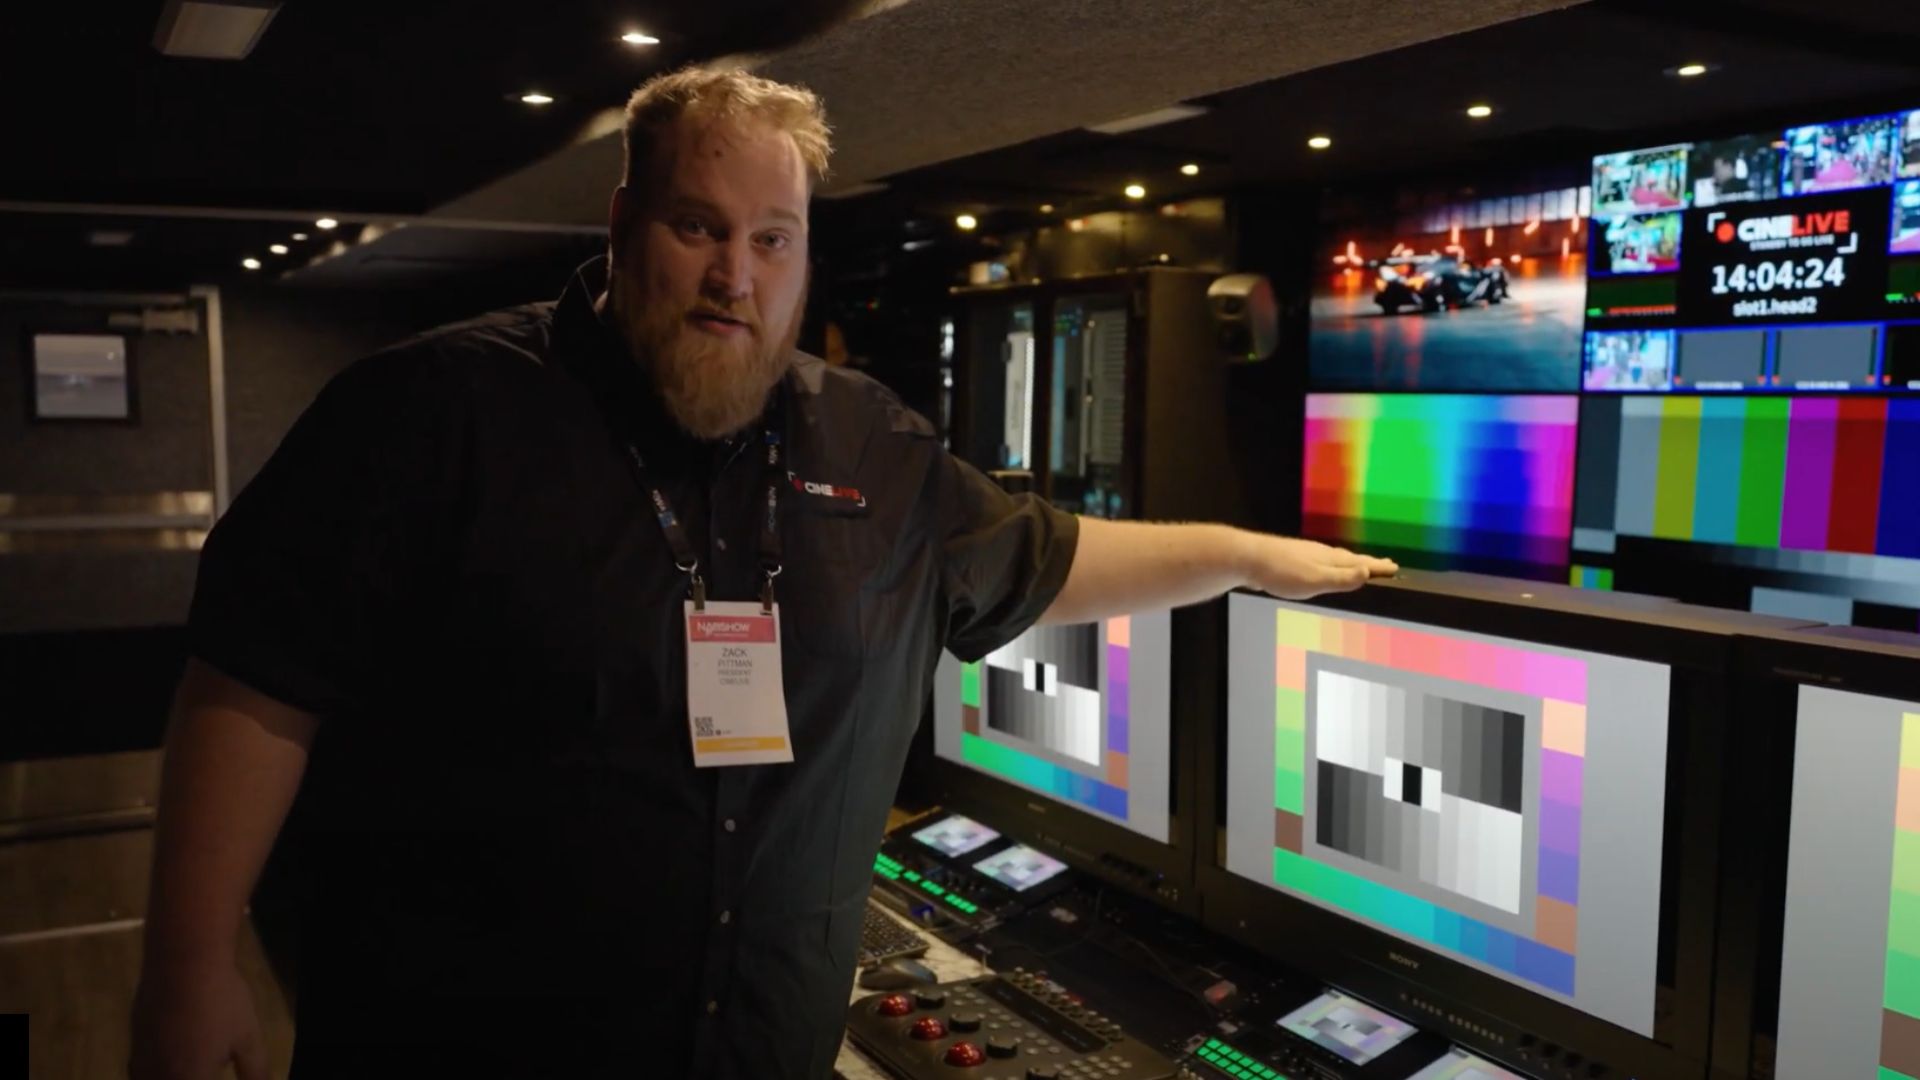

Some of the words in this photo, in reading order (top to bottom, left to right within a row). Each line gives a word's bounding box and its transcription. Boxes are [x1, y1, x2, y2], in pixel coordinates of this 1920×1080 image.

[1737, 210, 1850, 242] CINELIVE
[1711, 256, 1845, 294] 14:04:24
[804, 481, 861, 500] CINELIVE
[721, 647, 748, 658] ZACK
[717, 658, 753, 668] PITTMAN
